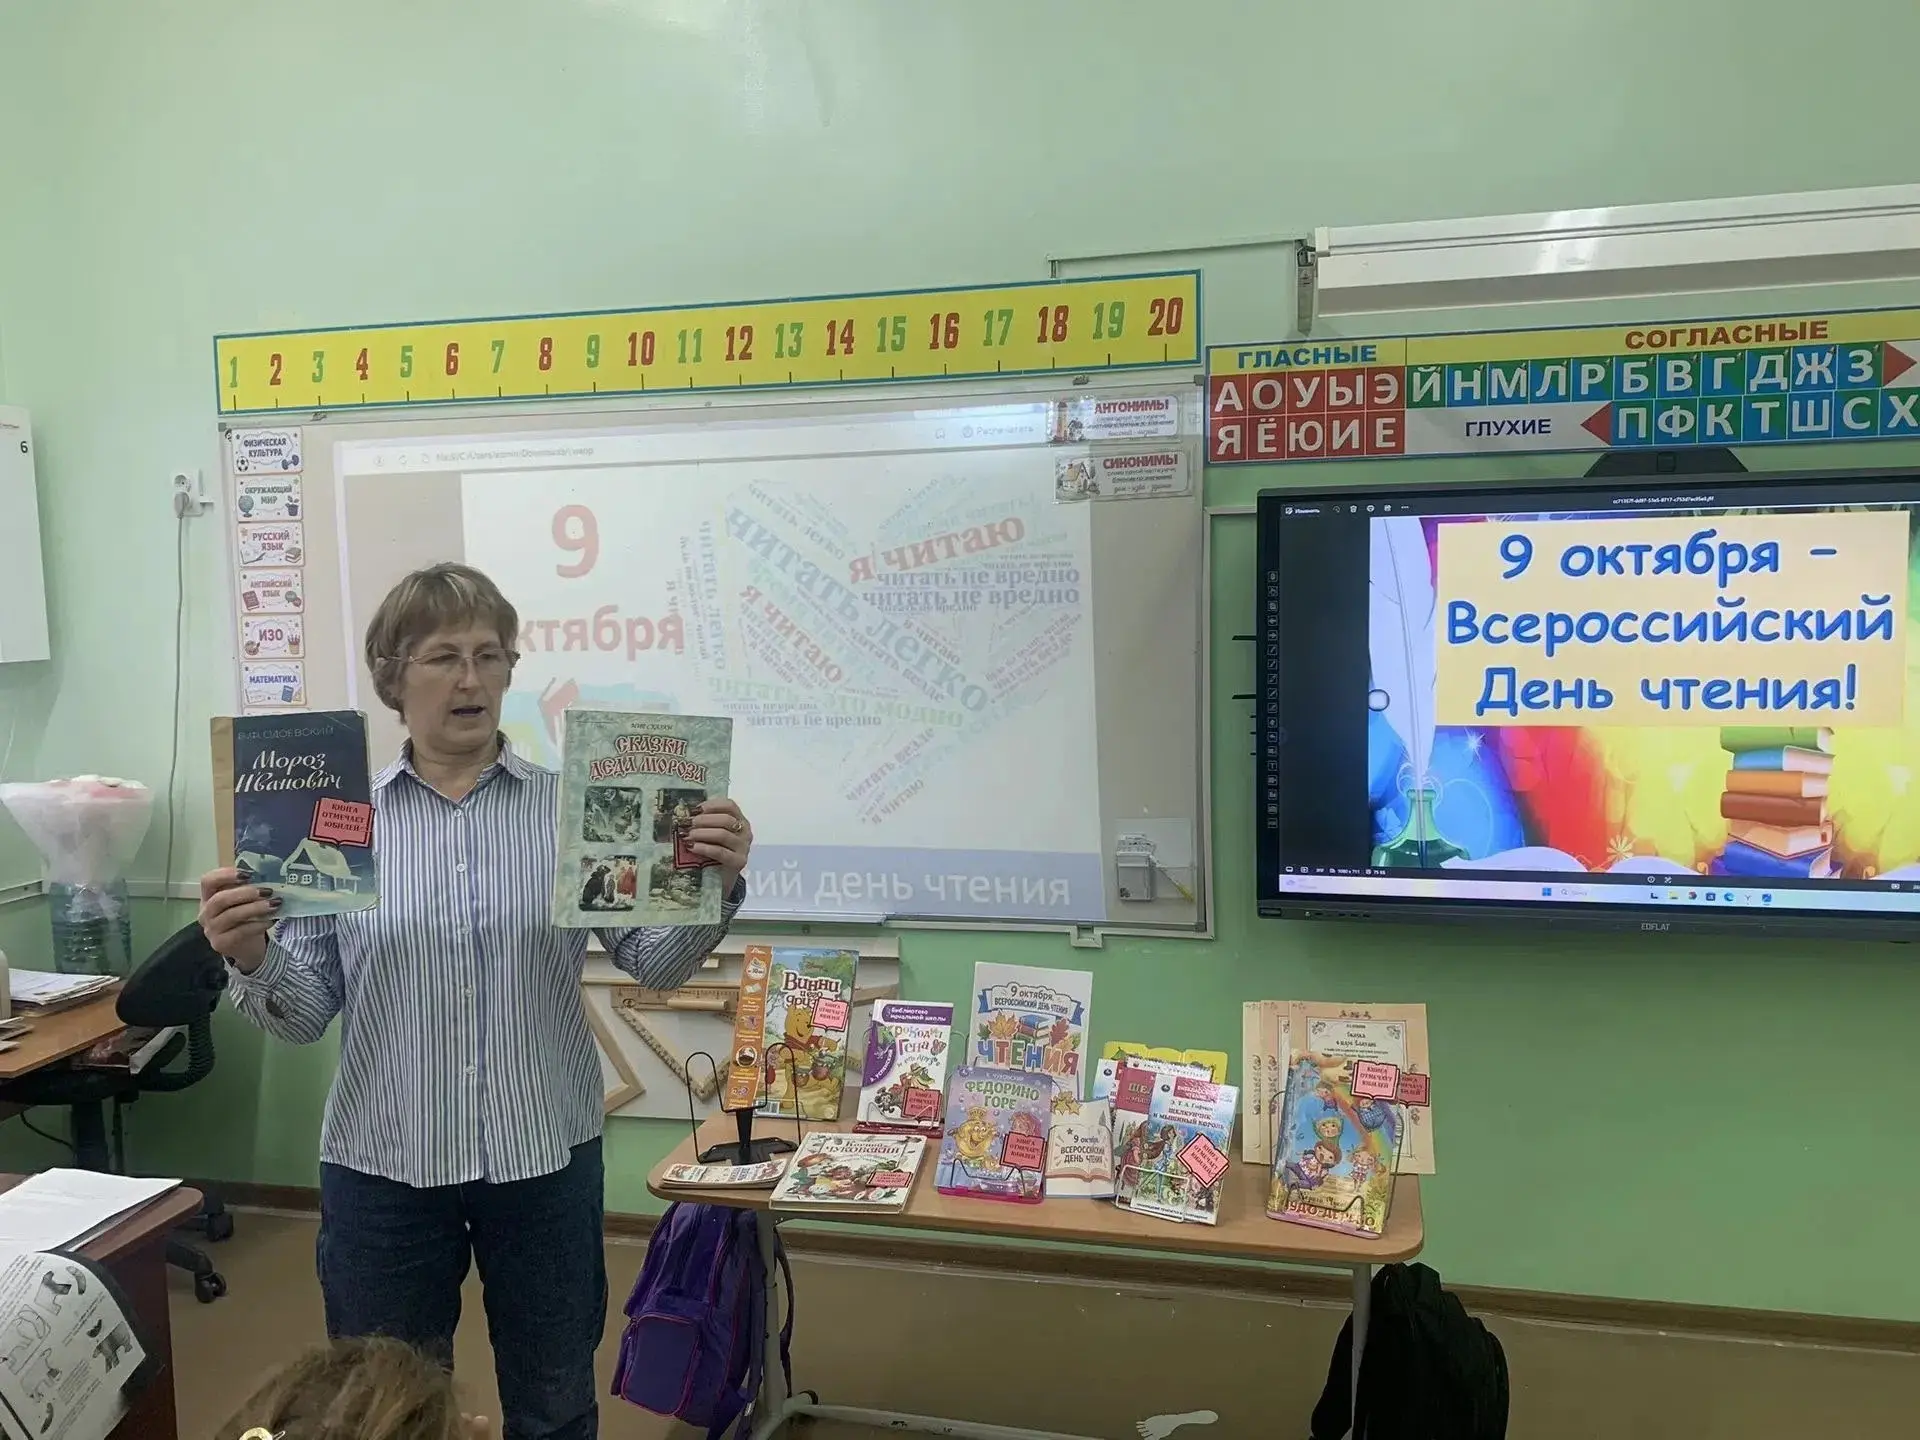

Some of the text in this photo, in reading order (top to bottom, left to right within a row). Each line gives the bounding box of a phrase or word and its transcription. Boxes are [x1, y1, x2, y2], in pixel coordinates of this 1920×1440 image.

[229, 297, 1183, 388] 1 2 3 4 5 6 7 8 9 10 11 12 13 14 15 16 17 18 19 20
[1625, 320, 1829, 350] СОГЛАСНЫЕ
[1238, 345, 1377, 369] ГЛАСНЫЕ
[1095, 399, 1169, 414] АНТОНИМЫ
[1465, 418, 1551, 437] ГЛУХИЕ
[20, 441, 28, 453] 6
[244, 438, 287, 447] ФИЗИЧЕСКАЯ
[248, 448, 283, 457] КУЛЬТУРА
[1102, 454, 1178, 469] СИНОНИМЫ
[244, 485, 292, 494] ОКРУЖАЮЩИЙ
[260, 496, 277, 504] МИР
[252, 530, 290, 540] РУССКИЙ
[552, 505, 600, 578] 9
[261, 542, 284, 550] ЯЗЫК
[849, 554, 876, 585] я
[881, 516, 1026, 572] читаю
[1500, 528, 1780, 589] 9 октября
[250, 579, 292, 588] АНГЛИЙСКИЙ
[877, 568, 1080, 590] читать не вредно
[726, 506, 859, 620] читать
[866, 617, 988, 711] легко
[862, 588, 1080, 611] читать не вредно
[519, 605, 685, 661] ктября
[739, 585, 764, 606] я
[764, 599, 843, 683] читаю
[1447, 593, 1893, 657] Всероссийский
[259, 629, 283, 641] ИЗО
[249, 675, 298, 684] МАТЕМАТИКА
[1476, 662, 1857, 718] День чтения!
[263, 725, 335, 740] ОДОЕВСКИЙ
[615, 734, 688, 756] СКАЗКИ
[252, 750, 326, 776] Мороз
[590, 756, 708, 784] ДЕДА МОРОЗА
[235, 770, 344, 793] Иванович
[321, 811, 366, 824] ОТМЕЧАЕТ
[331, 803, 358, 814] КНИГА
[323, 820, 361, 832] ЮБИЛЕЙ
[814, 866, 1071, 908] день чтения
[783, 971, 839, 993] Винни
[1011, 986, 1018, 997] 9
[891, 1007, 929, 1015] Библиотека
[994, 997, 1038, 1009] ВСЕРОССИЙСКИЙ
[899, 1039, 930, 1056] Гена
[977, 1040, 1080, 1076] ЧТЕНИЯ
[965, 1081, 1040, 1101] ФЕДОРИНО
[985, 1095, 1018, 1110] ГОРЕ
[1064, 1154, 1084, 1164] ДЕНЬ
